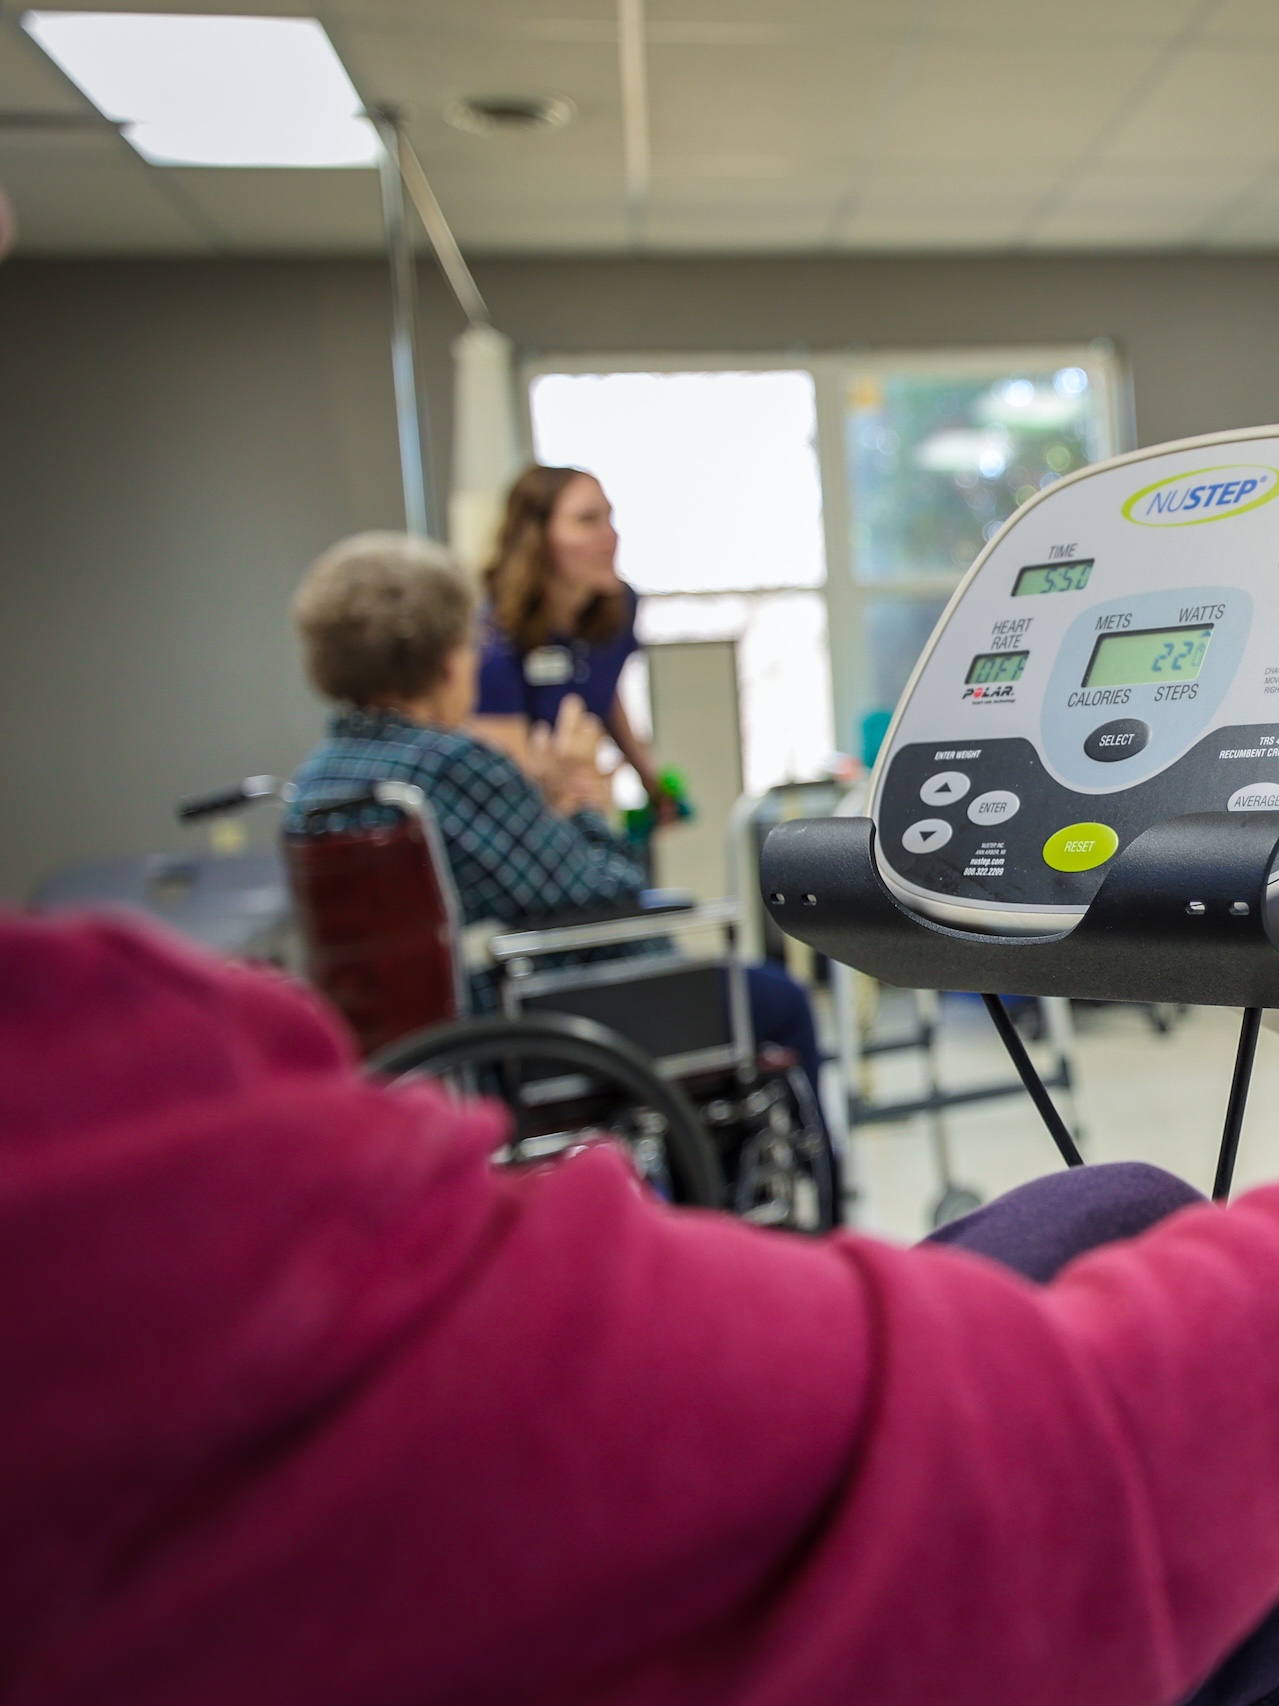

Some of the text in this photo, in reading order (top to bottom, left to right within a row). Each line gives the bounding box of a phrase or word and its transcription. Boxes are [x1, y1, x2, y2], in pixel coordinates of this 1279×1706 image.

[1048, 543, 1078, 559] TIME
[1095, 603, 1226, 630] METS WATTS
[992, 617, 1034, 635] HEART
[990, 633, 1023, 650] RATE
[962, 685, 1013, 699] POLAR
[1067, 684, 1199, 707] CALORIES STEPS
[1099, 733, 1135, 746] SELECT
[1259, 736, 1275, 746] TRS
[934, 749, 982, 760] ENTER WEIGHT
[1219, 748, 1266, 759] RECUMBENT
[978, 802, 1007, 813] ENTER
[1063, 840, 1096, 853] RESET
[970, 857, 1005, 866] nustep.com
